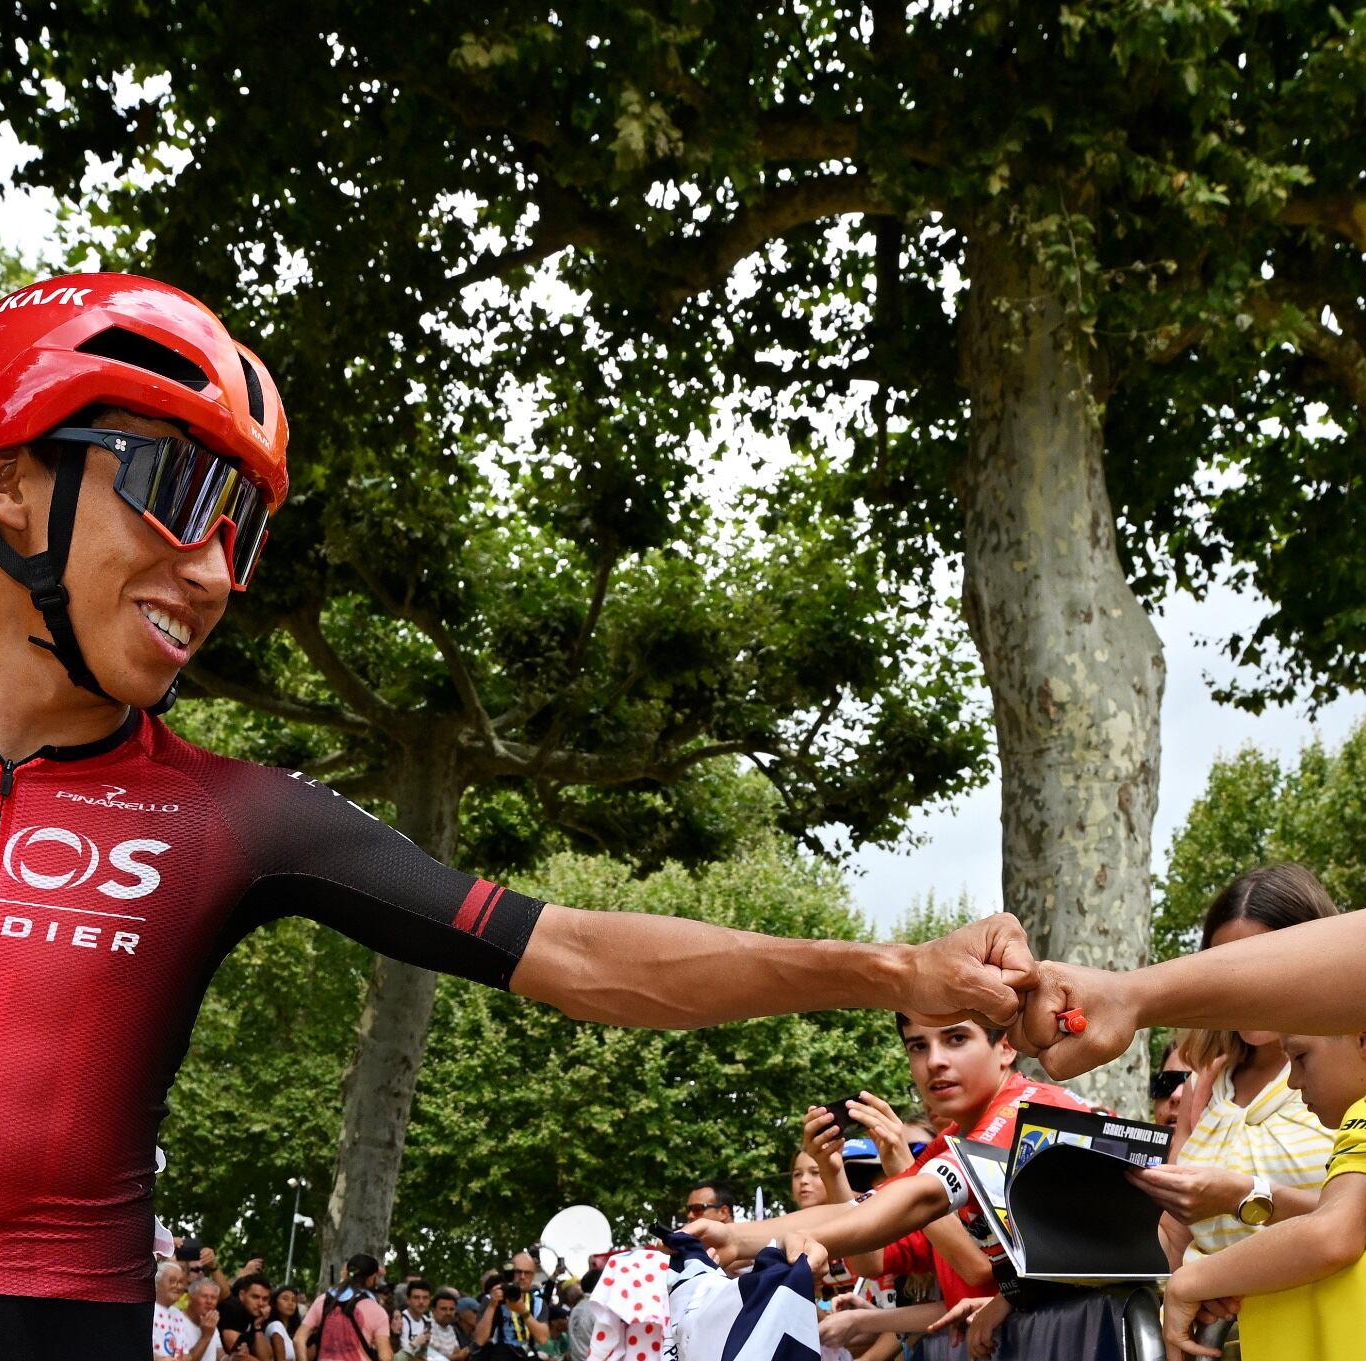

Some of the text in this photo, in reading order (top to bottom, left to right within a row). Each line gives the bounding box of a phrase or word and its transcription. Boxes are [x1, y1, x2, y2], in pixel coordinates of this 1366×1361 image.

[55, 789, 180, 814] PINARELLO
[1103, 1122, 1170, 1145] ISRAEL-PREMIER TECH
